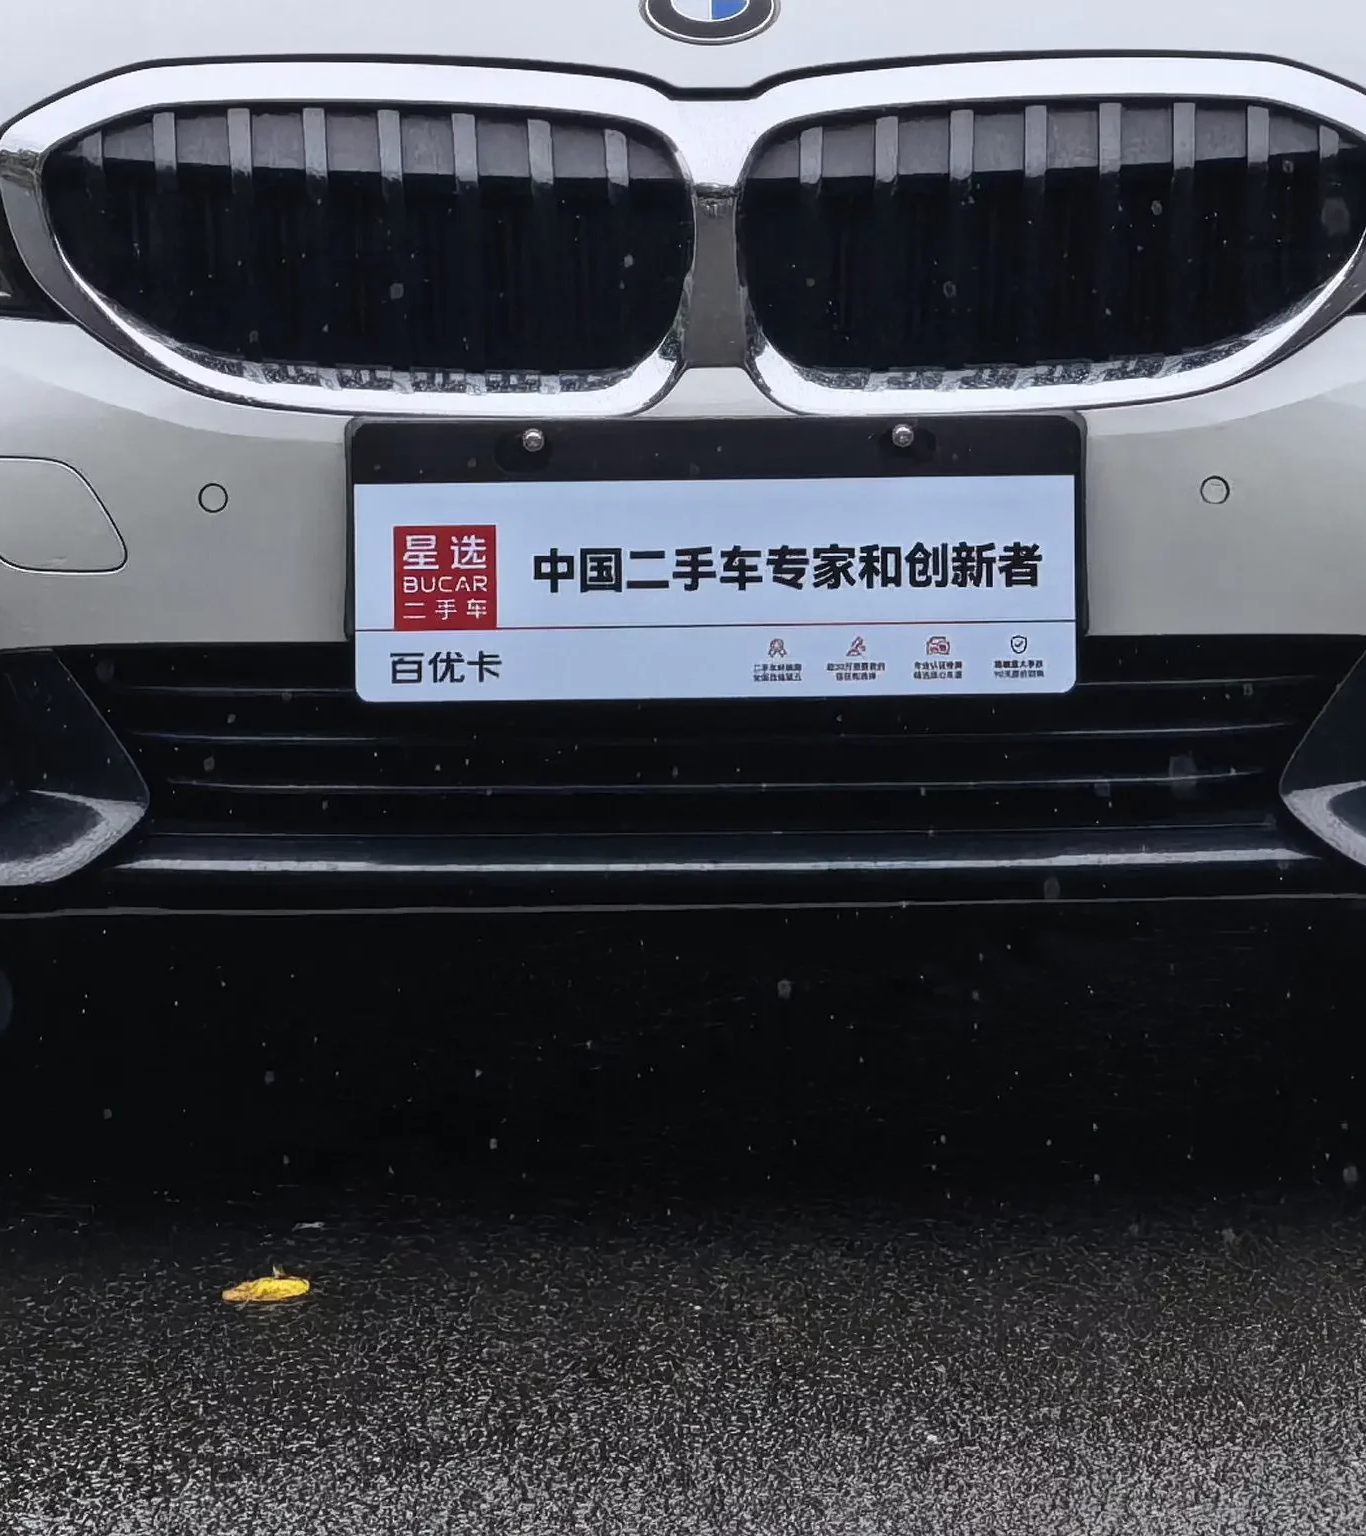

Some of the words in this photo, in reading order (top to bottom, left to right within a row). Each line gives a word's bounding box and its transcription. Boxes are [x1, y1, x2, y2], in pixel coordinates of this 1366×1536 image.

[402, 534, 487, 570] 星选
[533, 541, 1043, 594] 中国二手车专家和创新者
[403, 575, 488, 593] BUCAR
[403, 598, 487, 621] 二手车
[389, 650, 503, 684] 百优卡
